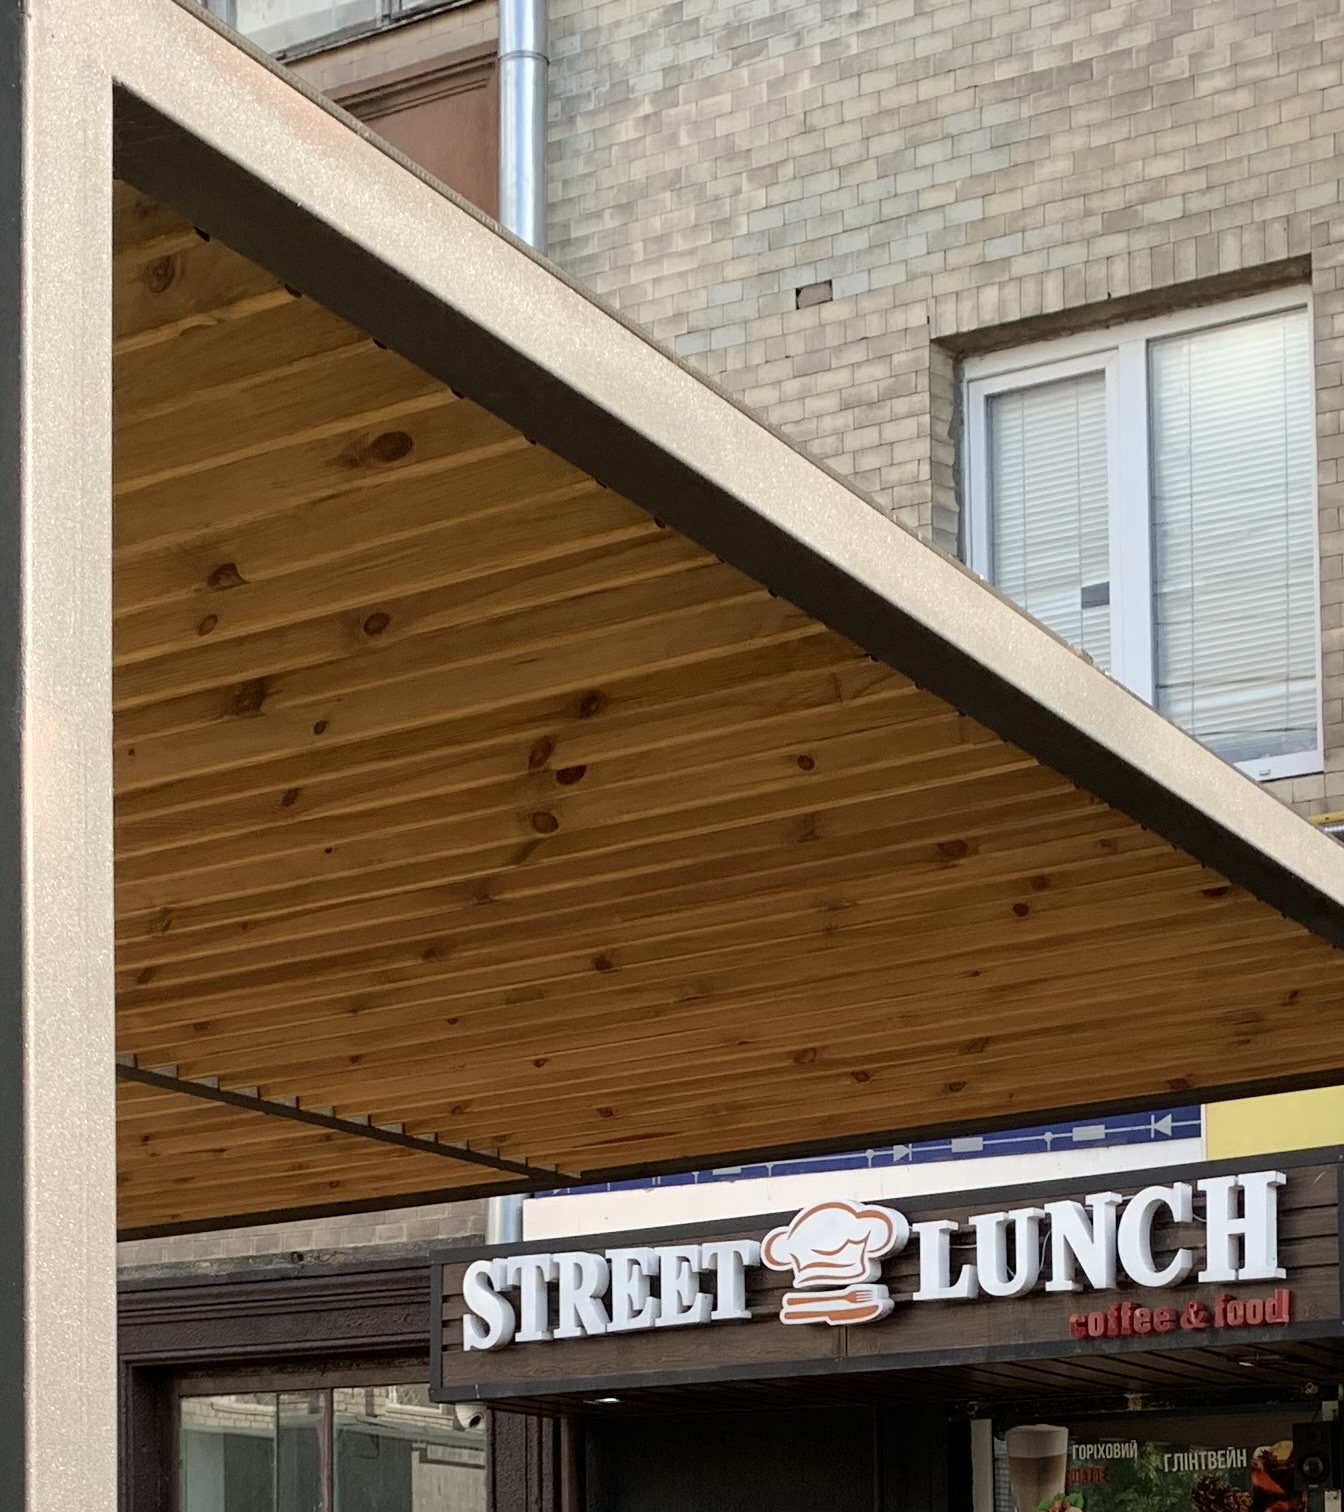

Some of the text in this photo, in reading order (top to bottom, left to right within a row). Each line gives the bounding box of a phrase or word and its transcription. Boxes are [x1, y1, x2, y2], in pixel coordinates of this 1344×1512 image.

[463, 1170, 1288, 1353] STREET LUNCH
[1069, 1287, 1292, 1340] coffee & food
[1072, 1440, 1138, 1460] ГОРІХОВИЙ
[1164, 1447, 1248, 1473] ГЛІНТВЕЙН
